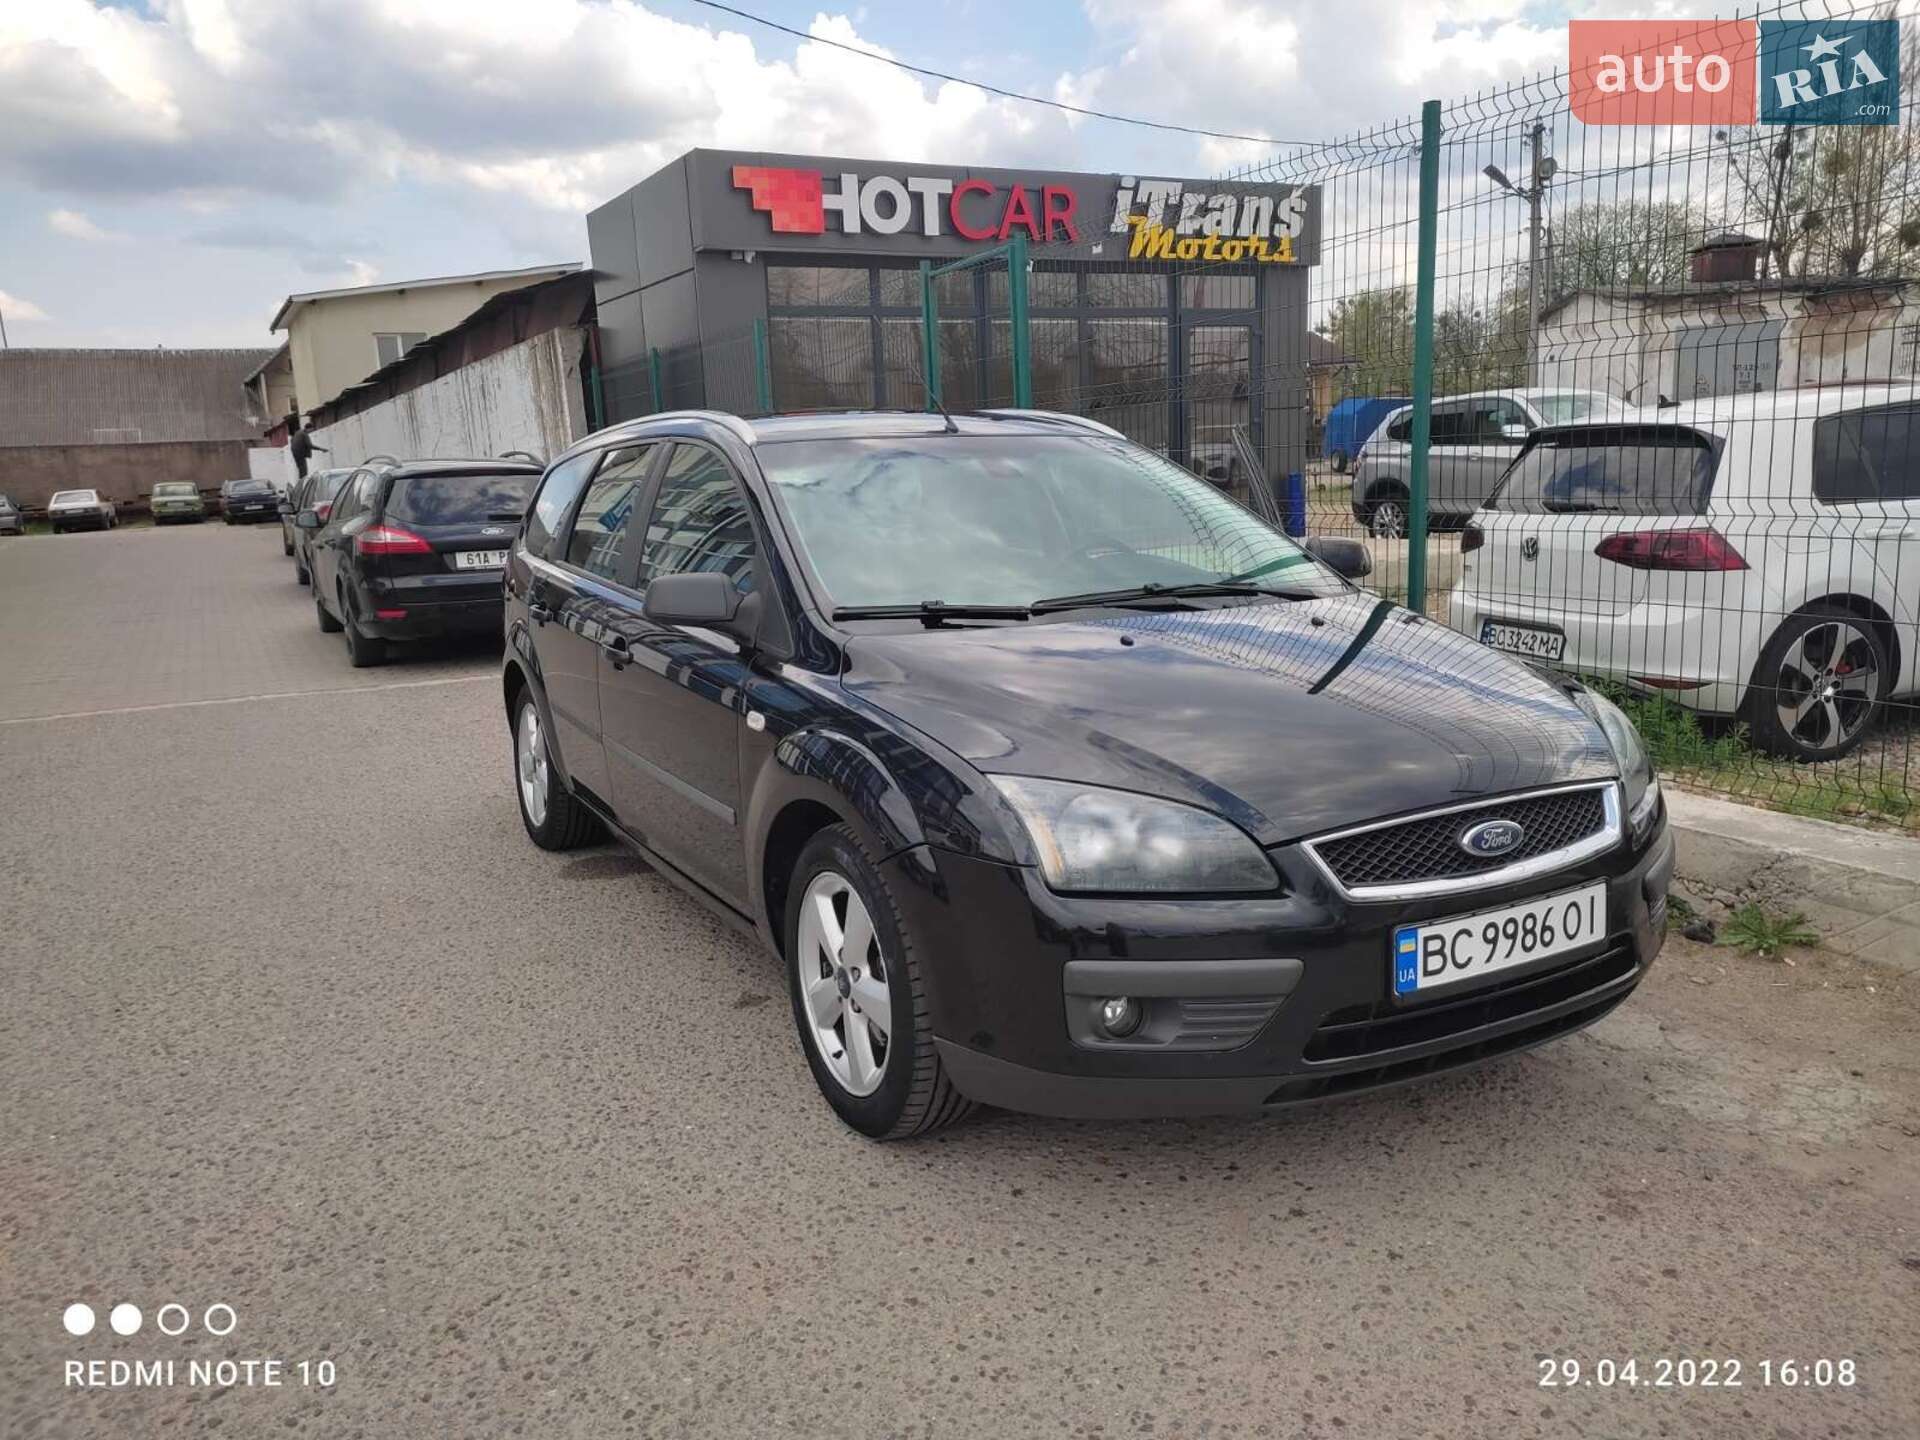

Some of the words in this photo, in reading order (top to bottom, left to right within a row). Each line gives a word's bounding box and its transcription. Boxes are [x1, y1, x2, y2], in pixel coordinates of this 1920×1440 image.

[1127, 215, 1299, 262] Motors
[1481, 827, 1513, 849] Ford
[1399, 968, 1416, 983] UA
